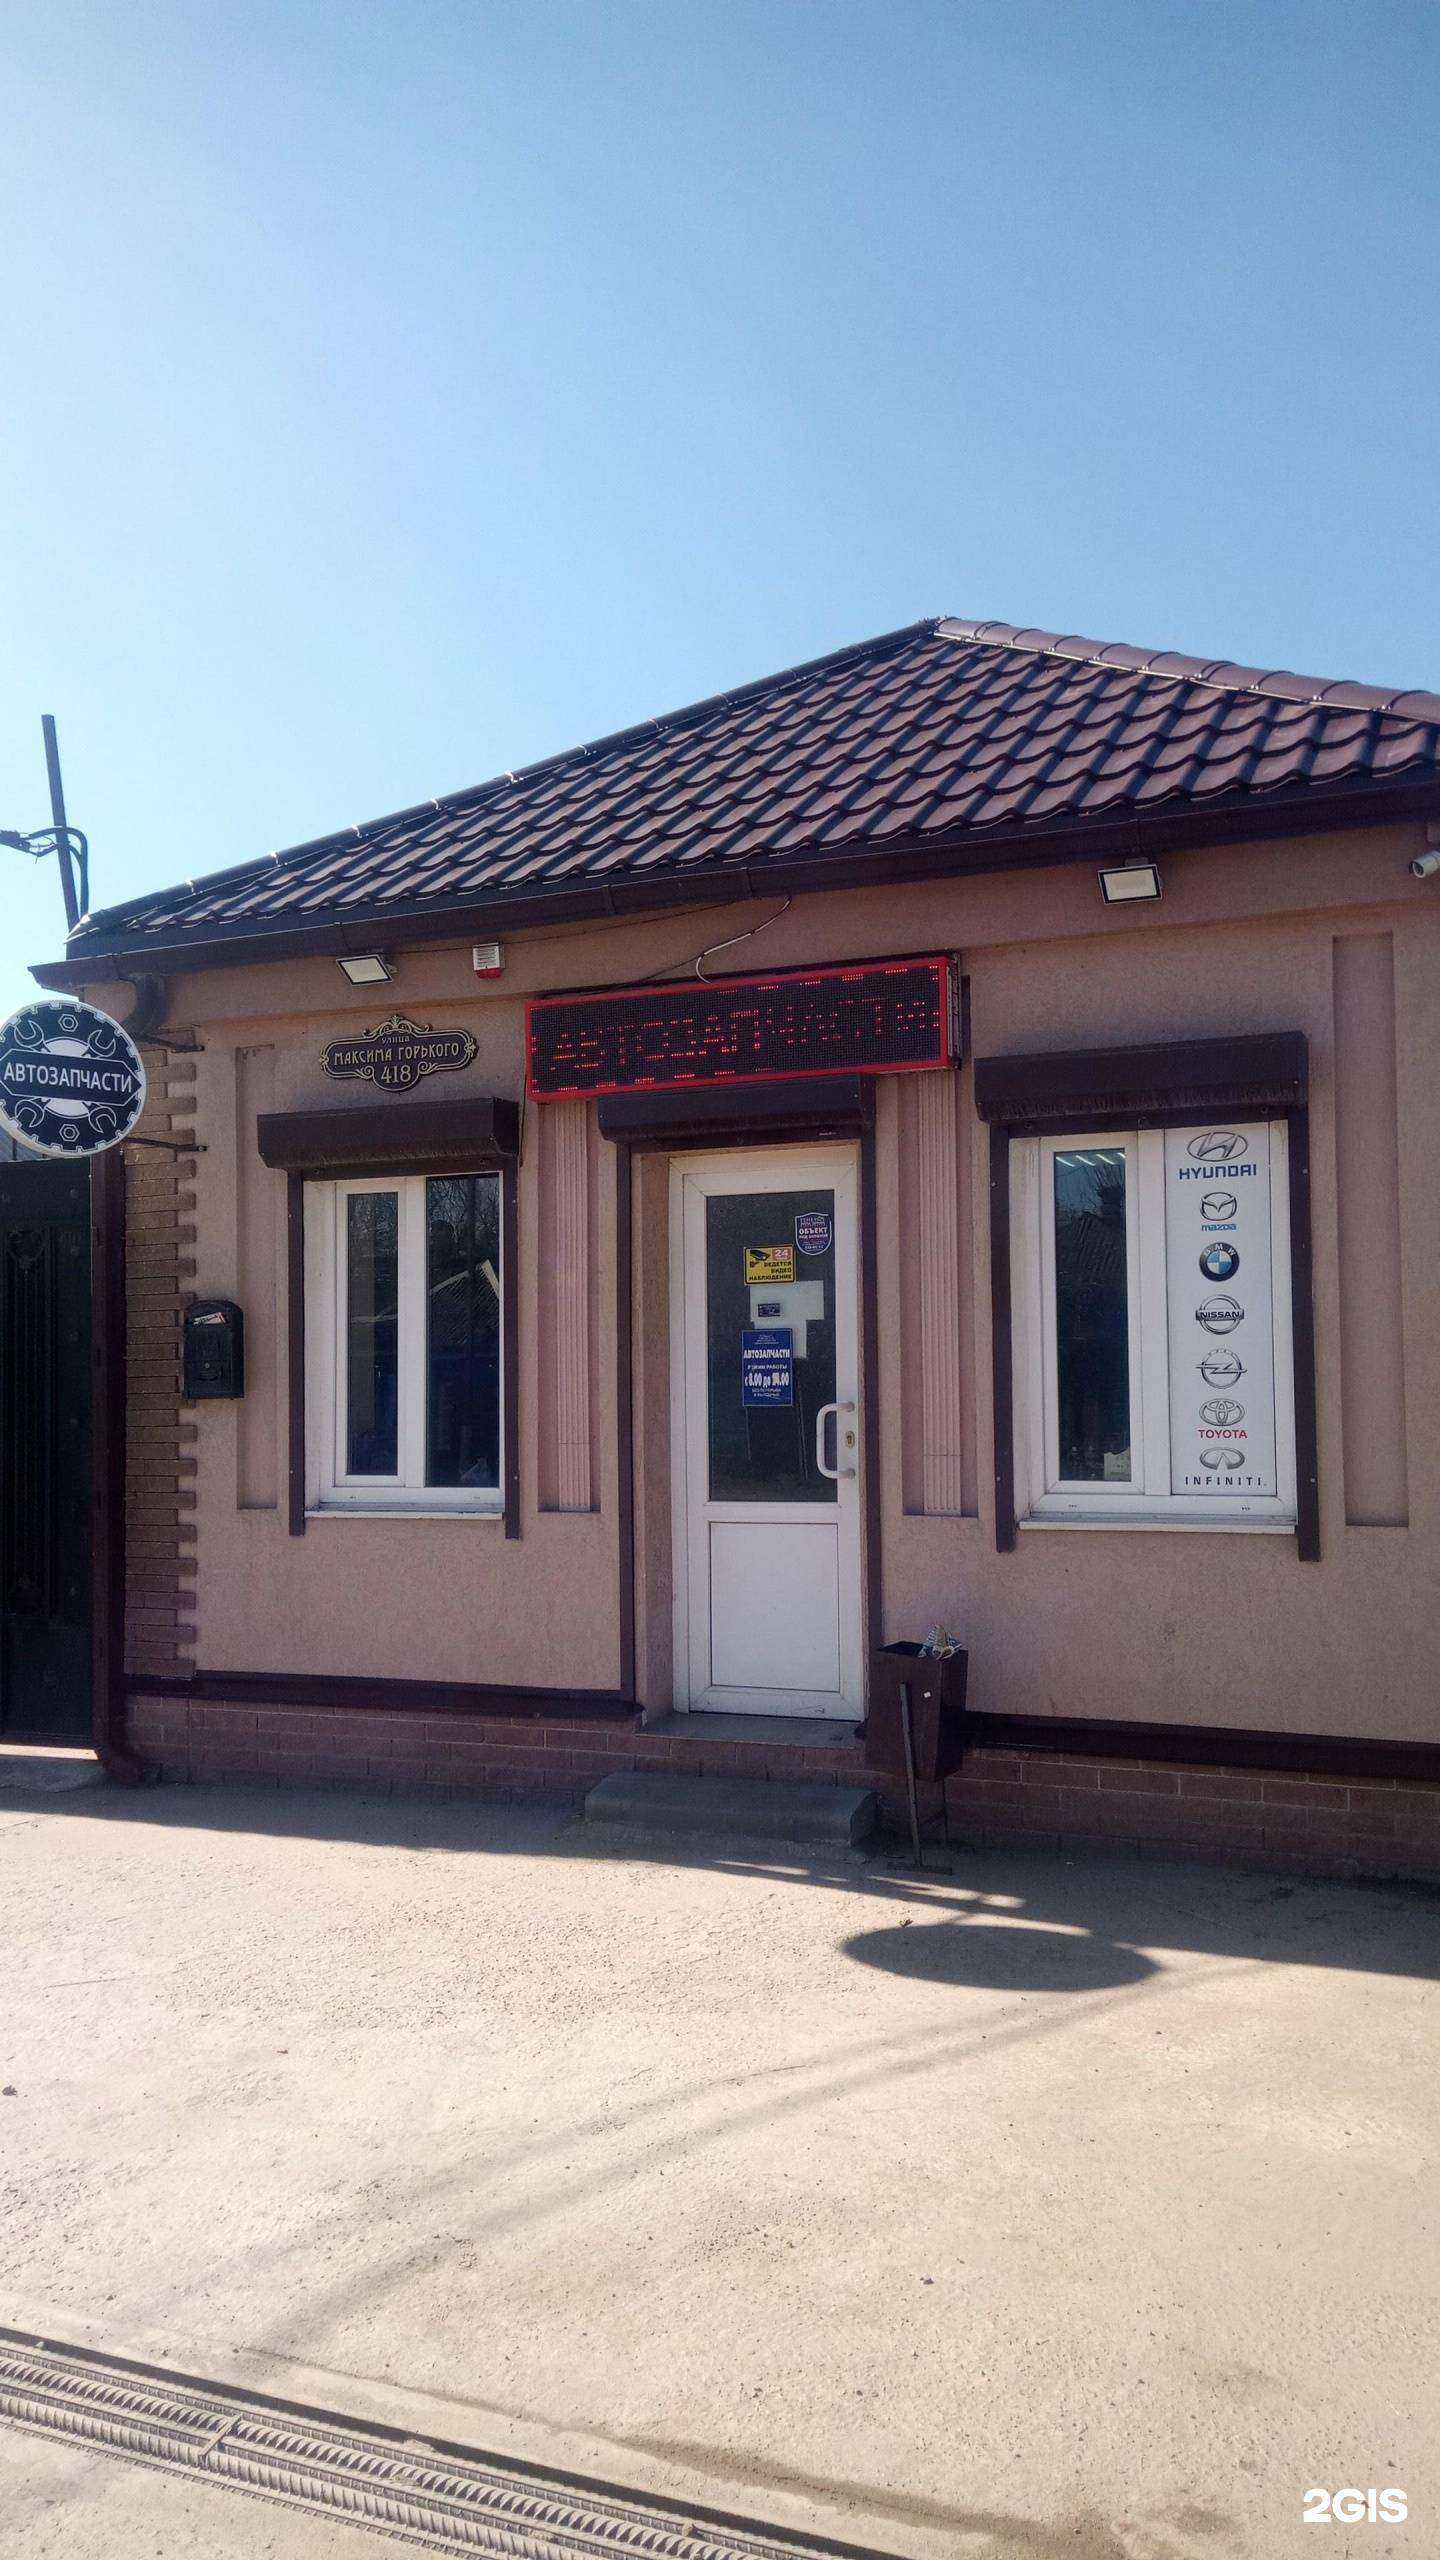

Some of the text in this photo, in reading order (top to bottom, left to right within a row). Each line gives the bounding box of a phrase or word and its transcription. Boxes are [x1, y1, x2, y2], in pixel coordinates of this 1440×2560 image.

[334, 1042, 459, 1065] МАКСИМА ГОРЬКОГО
[4, 1062, 132, 1093] АВТОЗАПЧАСТИ
[381, 1064, 411, 1084] 418
[1179, 1164, 1257, 1180] HYUNDAI
[799, 1227, 828, 1235] ОБЪЕКТ
[1201, 1223, 1237, 1231] mazda
[775, 1249, 789, 1257] 24
[1200, 1311, 1240, 1319] NISSAN
[744, 1349, 790, 1358] АВТОЗАПЧАСТИ
[1198, 1429, 1248, 1439] TOYOTA
[1185, 1476, 1261, 1486] INFINITI
